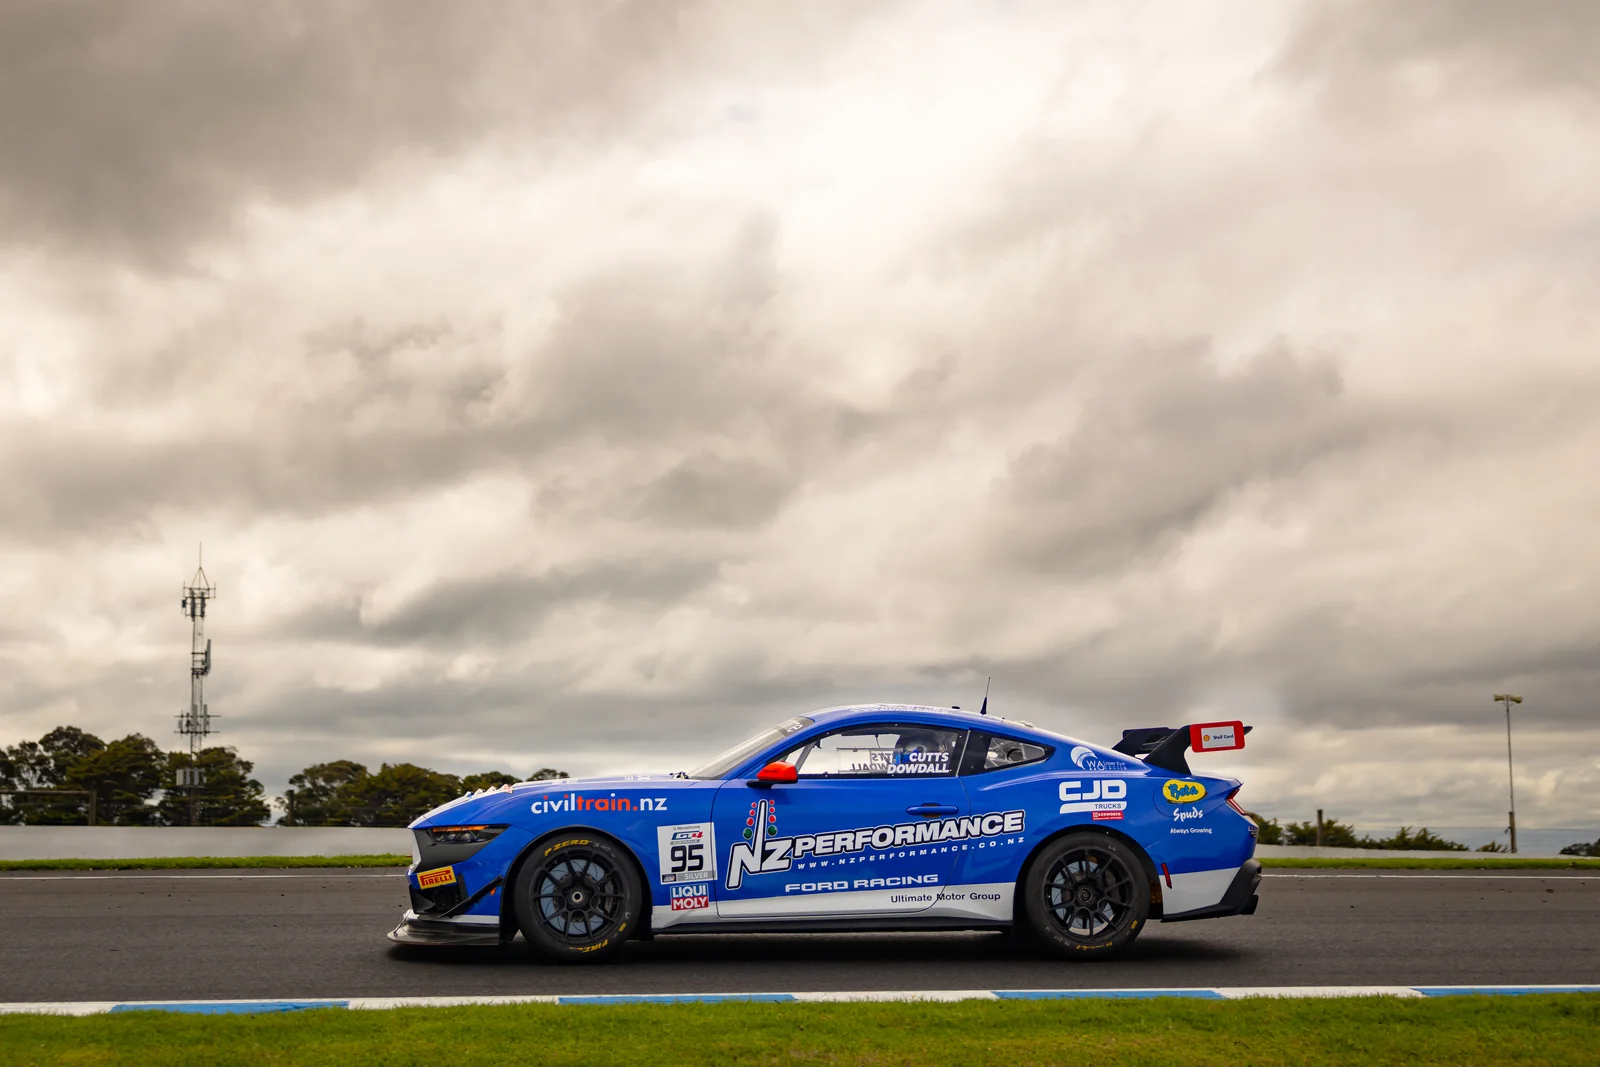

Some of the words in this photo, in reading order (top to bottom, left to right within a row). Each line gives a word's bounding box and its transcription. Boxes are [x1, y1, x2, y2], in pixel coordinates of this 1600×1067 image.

[909, 752, 949, 762] CUTTS
[887, 763, 950, 774] DOWDALL
[1059, 779, 1127, 801] CJD
[531, 793, 668, 814] civiltrain.nz
[1173, 806, 1204, 822] Spuds
[1170, 827, 1190, 835] Always
[1190, 827, 1212, 835] Growing
[552, 839, 590, 852] ZERO
[671, 844, 703, 872] 95
[797, 836, 1025, 869] WWW.NZPERFORMANCE.CO.NZ
[419, 869, 453, 887] PIRELLI
[684, 872, 709, 880] SILVER
[785, 881, 849, 893] FORD
[853, 874, 939, 889] RACING
[672, 885, 707, 898] LIQUI
[890, 893, 933, 903] Ultimate
[936, 892, 966, 902] Motor
[969, 892, 1001, 902] Group
[673, 897, 708, 910] MOLY
